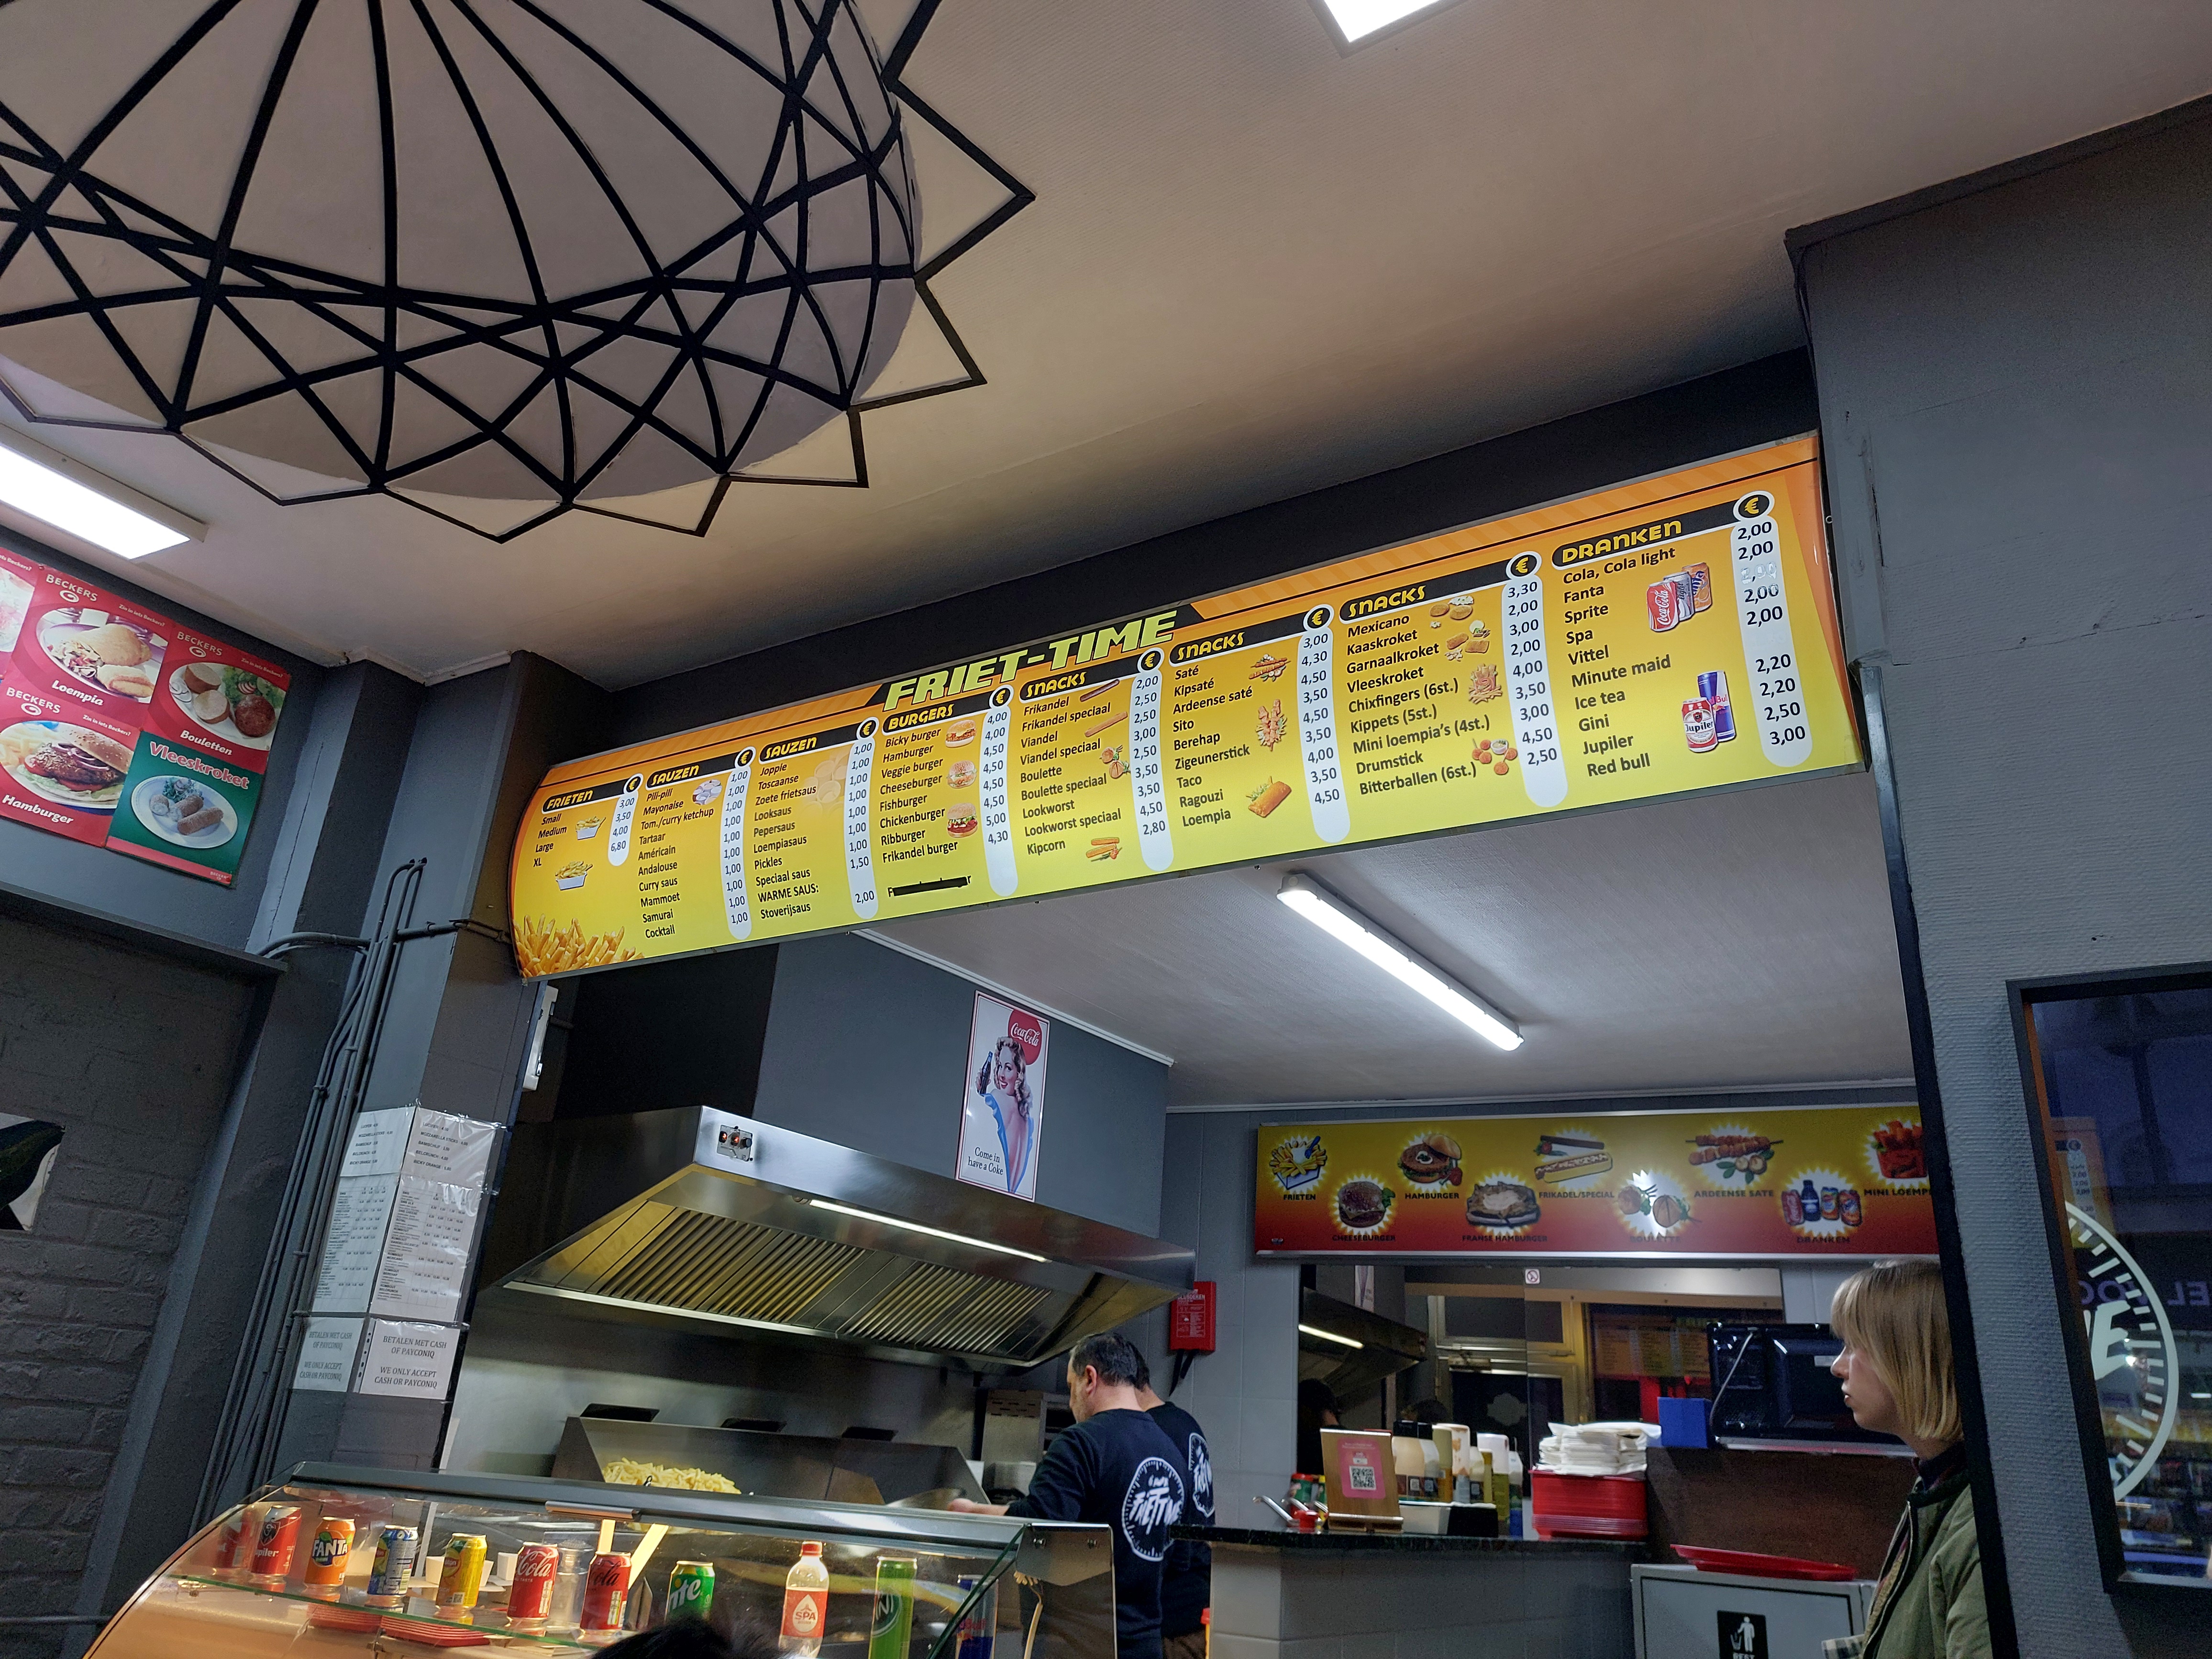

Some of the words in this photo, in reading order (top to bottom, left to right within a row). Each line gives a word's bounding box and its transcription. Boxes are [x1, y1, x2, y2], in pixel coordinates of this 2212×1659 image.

[1562, 520, 1681, 563] DRANKEN
[1563, 568, 1600, 584] Cola,
[1604, 558, 1637, 574] Cola
[1641, 547, 1676, 566] light
[46, 574, 98, 602] BECKERS
[1564, 586, 1604, 604] Fanta
[1349, 586, 1426, 617] SNACKS
[1564, 605, 1609, 625] Sprite
[1348, 615, 1410, 638] Mexicano
[177, 631, 223, 656] BECKERS
[1177, 632, 1244, 661] SNACKS
[1347, 630, 1418, 656] Kaaskroket
[1566, 630, 1593, 646] Spa
[883, 609, 1178, 712] FRIET-TIME
[1346, 643, 1439, 674] Garnaalkroket
[1567, 644, 1609, 665] Vittel
[1755, 653, 1791, 675] 2,20
[1175, 664, 1199, 680] Saté
[1347, 666, 1424, 693] Vleeskroket
[1571, 667, 1627, 688] Minute
[1631, 654, 1671, 675] maid
[52, 680, 104, 707] Loempia
[1026, 672, 1086, 697] SNACKS
[1174, 677, 1215, 697] Kipsaté
[6, 687, 61, 714] BECKERS
[1172, 695, 1226, 715] Ardeense
[1228, 685, 1252, 702] saté
[1349, 689, 1420, 713] Chixfingers
[1424, 677, 1459, 700] (6st.)
[1574, 697, 1597, 710] Ice
[1600, 691, 1626, 705] tea
[1023, 696, 1070, 716] Frikandel
[1764, 702, 1801, 722] 2,50
[888, 704, 954, 730] BURGERS
[1022, 712, 1068, 732] Frikandel
[1069, 702, 1111, 723] speciaal
[1172, 719, 1194, 732] Sito
[1350, 714, 1400, 734] Kippets
[1403, 703, 1437, 725] (5st.)
[1579, 713, 1610, 732] Gini
[1685, 721, 1714, 733] Jupiler
[180, 730, 232, 756] Bouletten
[885, 735, 909, 748] Bicky
[910, 729, 941, 742] burger
[1021, 730, 1058, 748] Viandel
[1173, 733, 1220, 751] Berehap
[1353, 739, 1383, 754] Mini
[1454, 714, 1490, 737] (4st.)
[1770, 726, 1805, 746] 3,00
[764, 737, 817, 759] SAUZEN
[883, 745, 934, 763] Hamburger
[1020, 747, 1057, 765] Viandel
[1060, 738, 1100, 759] speciaal
[1583, 735, 1634, 755] Jupiler
[150, 741, 250, 789] Vleeskroket
[1174, 743, 1250, 771] Zigeunerstick
[1356, 750, 1424, 774] Drumstick
[1587, 758, 1617, 777] Red
[1620, 752, 1650, 771] bull
[651, 765, 699, 785] SAUZEN
[760, 763, 787, 776] Joppie
[881, 764, 911, 779] Veggie
[913, 758, 943, 772] burger
[1020, 766, 1062, 783] Boulette
[1360, 772, 1438, 795] Bitterballen
[1441, 761, 1476, 783] (6st.)
[758, 775, 799, 791] Toscaanse
[880, 775, 943, 795] Cheeseburger
[1021, 784, 1063, 801] Boulette
[1066, 773, 1107, 794] speciaal
[1176, 776, 1202, 788] Taco
[547, 790, 593, 809] FRIETEN
[646, 787, 674, 802] Pili-pili
[755, 794, 779, 806] Zoete
[780, 786, 817, 801] frietsaus
[880, 795, 928, 812] Fishburger
[1179, 788, 1224, 808] Ragouzi
[2, 795, 74, 824] Hamburger
[642, 800, 684, 816] Mayonaise
[754, 807, 792, 821] Looksaus
[1022, 799, 1075, 819] Lookworst
[1182, 808, 1231, 827] Loempia
[541, 813, 562, 826] Small
[641, 815, 682, 830] Tom./curry
[683, 808, 714, 821] ketchup
[880, 808, 945, 829] Chickenburger
[1024, 818, 1078, 837] Lookworst
[1079, 807, 1121, 829] speciaal
[538, 827, 567, 839] Medium
[639, 833, 666, 845] Tartaar
[753, 822, 796, 838] Pepersaus
[881, 830, 926, 846] Ribburger
[535, 842, 554, 853] Large
[638, 845, 676, 861] Américain
[753, 836, 807, 854] Loempiasaus
[882, 845, 925, 863] Frikandel
[927, 841, 958, 855] burger
[1027, 840, 1066, 856] Kipcorn
[533, 857, 542, 867] XL
[638, 862, 678, 876] Andalouse
[754, 856, 783, 870] Pickles
[639, 881, 659, 892] Curry
[661, 877, 678, 888] saus
[755, 870, 790, 888] Speciaal
[791, 869, 811, 880] saus
[640, 892, 680, 908] Mammoet
[757, 887, 792, 903] WARME
[793, 883, 819, 896] SAUS:
[642, 908, 674, 923] Samurai
[760, 903, 811, 919] Stoverijsaus
[645, 924, 675, 939] Cocktail
[421, 1132, 445, 1140] MOZZARELLA
[974, 1147, 993, 1161] Come
[994, 1153, 1000, 1163] in
[968, 1156, 983, 1169] have
[988, 1162, 1003, 1175] Coke
[1539, 1191, 1615, 1199] FRIKADEL/SPECIAL
[383, 1336, 413, 1345] BETALEN
[430, 1340, 447, 1349] CASH
[401, 1348, 435, 1359] PAYCONIQ
[404, 1379, 437, 1389] PAYCONIQ
[795, 1611, 816, 1621] SPA
